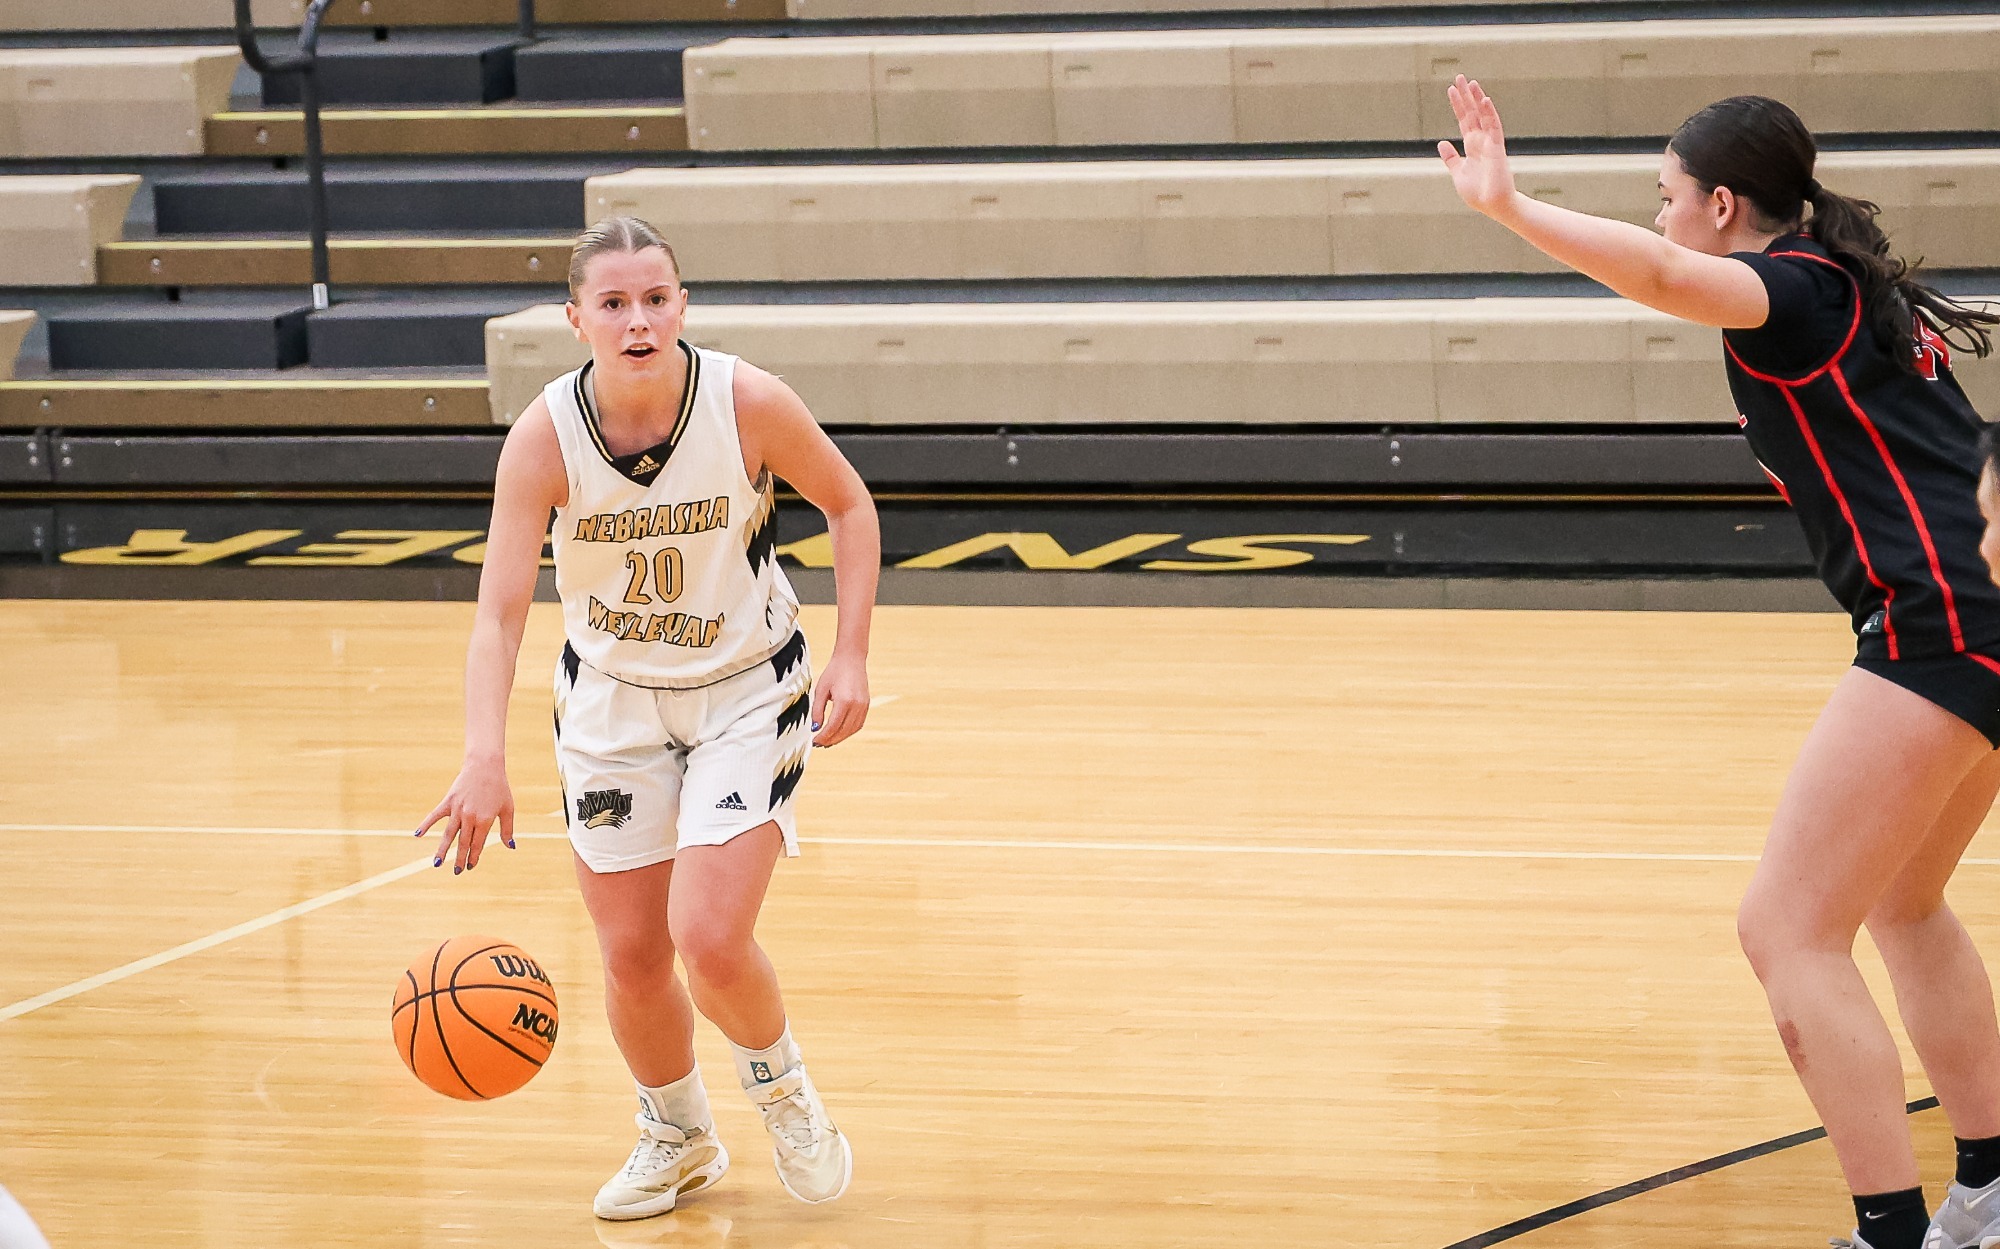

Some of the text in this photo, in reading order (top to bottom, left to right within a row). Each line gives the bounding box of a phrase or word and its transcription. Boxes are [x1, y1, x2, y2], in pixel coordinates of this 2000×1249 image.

[631, 462, 660, 476] adidas
[573, 496, 729, 543] NEBRASKA
[58, 529, 1372, 571] SNER
[622, 547, 684, 605] 20
[576, 788, 633, 821] NWU
[715, 801, 747, 811] adidas
